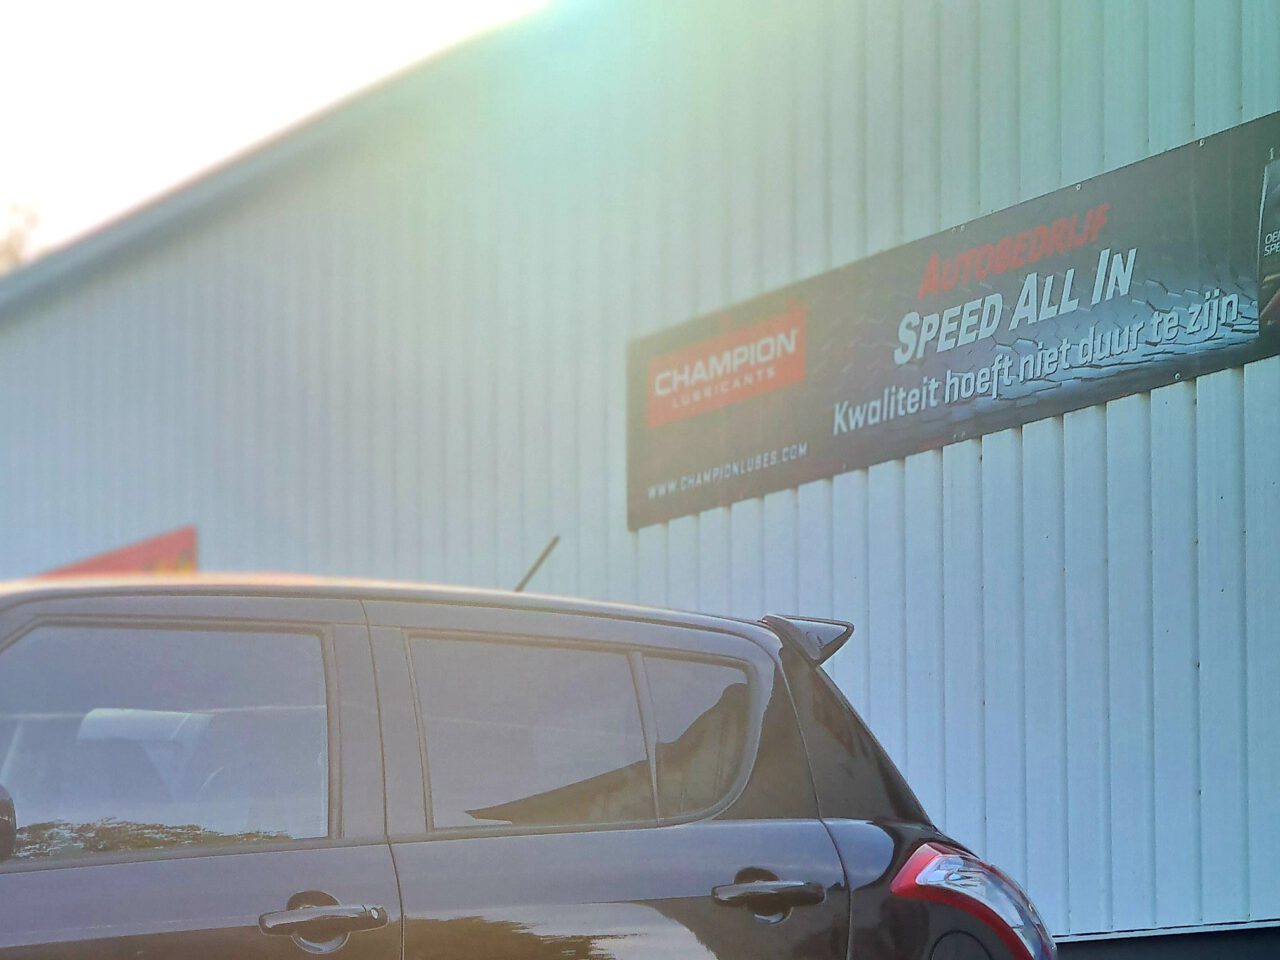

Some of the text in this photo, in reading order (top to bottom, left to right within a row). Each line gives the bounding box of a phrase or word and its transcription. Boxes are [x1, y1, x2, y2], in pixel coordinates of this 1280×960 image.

[919, 203, 1112, 297] AUTOBEDRIJF
[894, 248, 1138, 365] SPEED ALL IN
[654, 327, 799, 396] CHAMPION
[672, 366, 776, 409] LUBRICANTS
[833, 288, 1239, 436] Kwaliteit hoeft niet duur te zijn
[647, 442, 808, 499] WWW.CHAMPIONLUBES.COM
